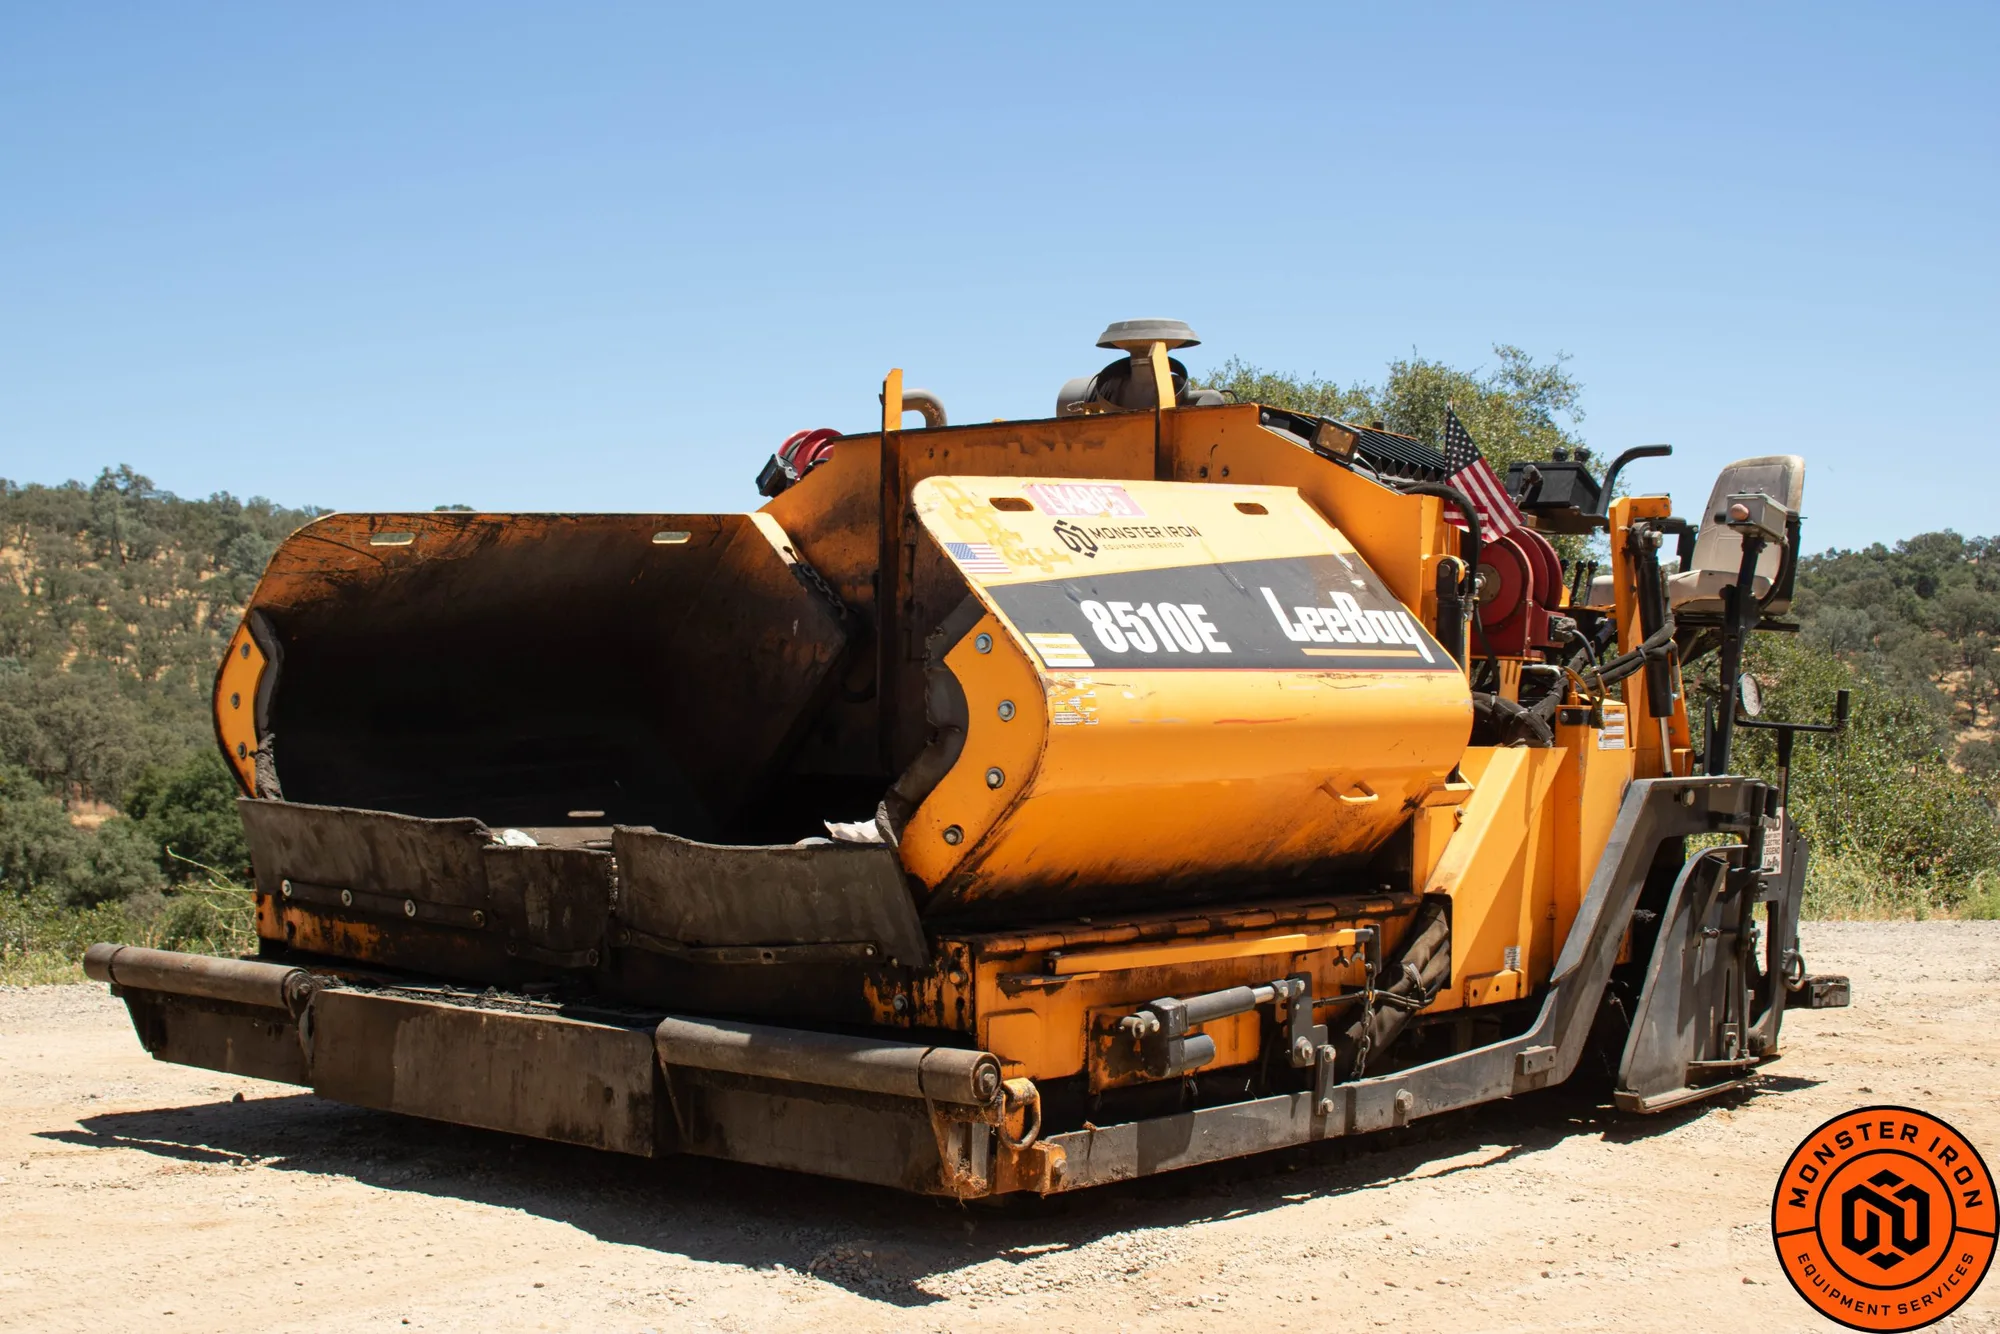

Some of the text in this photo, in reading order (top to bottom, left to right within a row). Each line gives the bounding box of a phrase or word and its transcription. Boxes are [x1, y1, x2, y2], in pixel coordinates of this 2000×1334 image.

[1088, 525, 1203, 539] MONSTER IRON
[1102, 543, 1147, 551] EQUIPMENT
[1079, 599, 1233, 653] 8510E
[1260, 586, 1436, 664] LeeBoy
